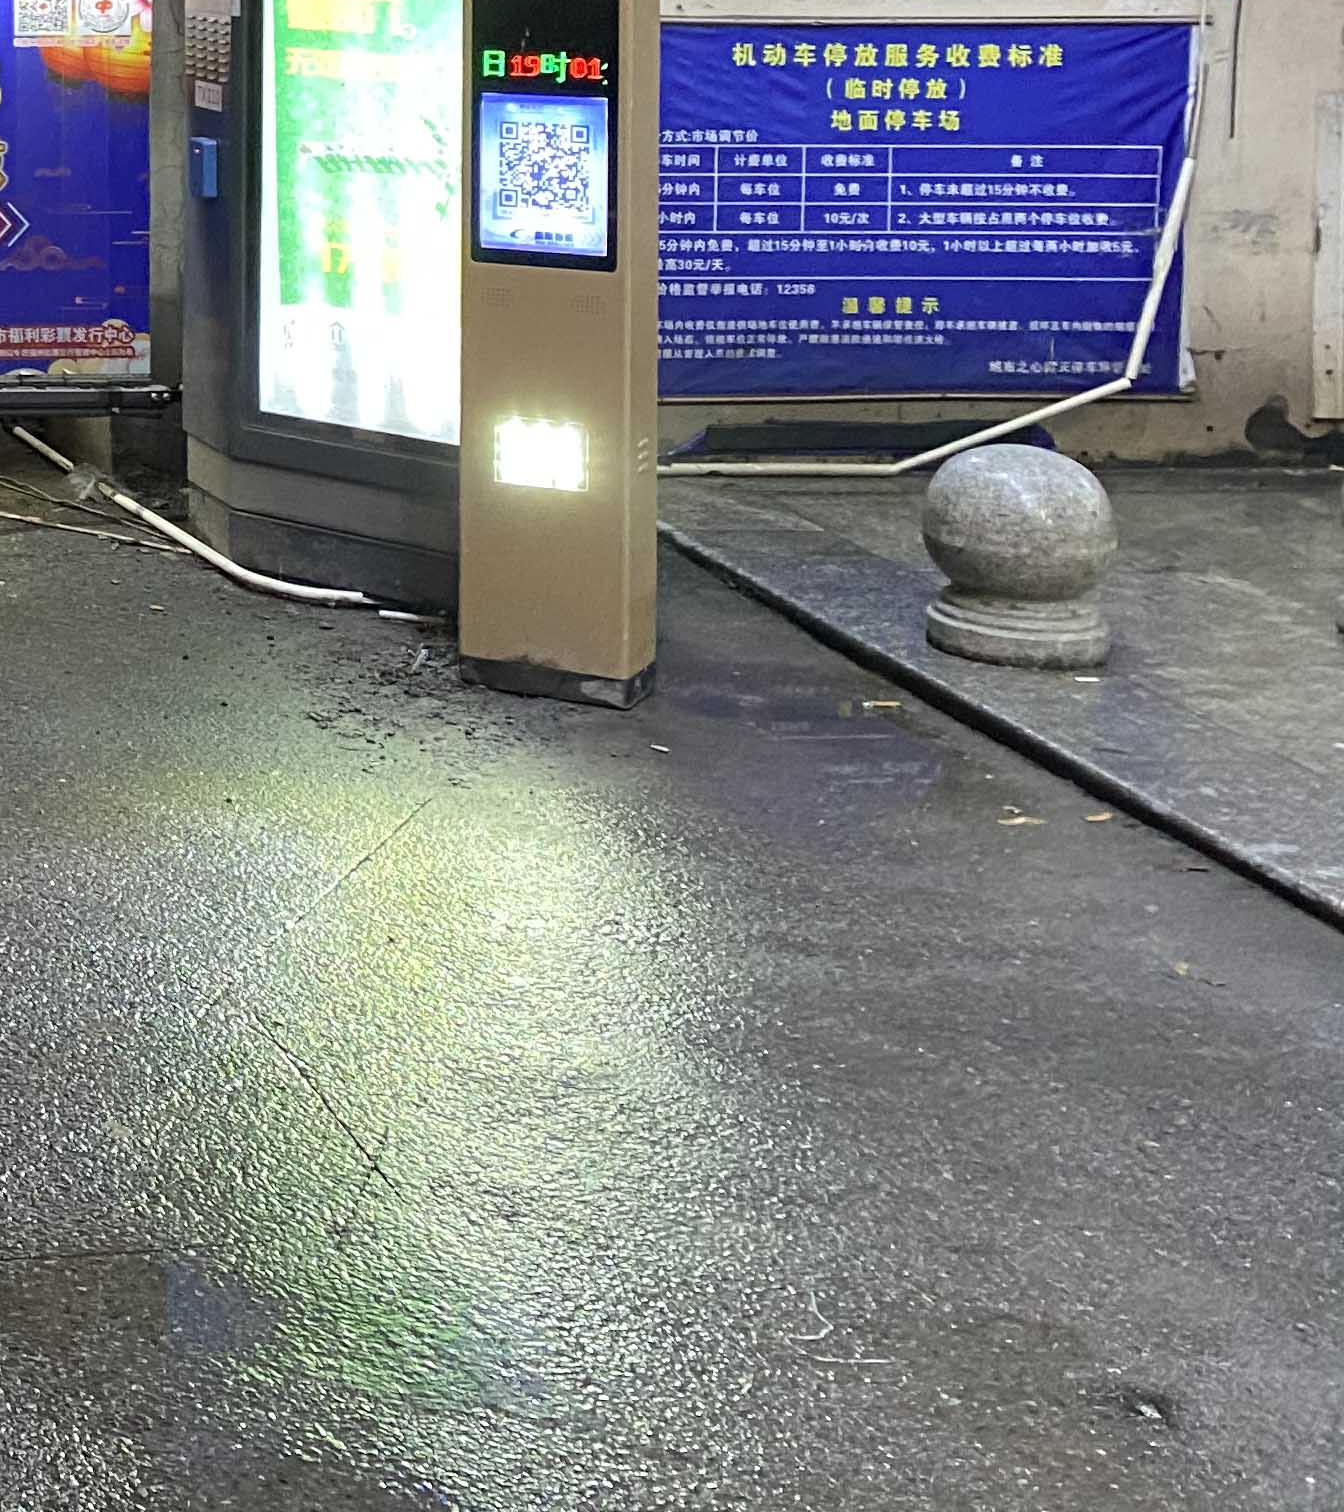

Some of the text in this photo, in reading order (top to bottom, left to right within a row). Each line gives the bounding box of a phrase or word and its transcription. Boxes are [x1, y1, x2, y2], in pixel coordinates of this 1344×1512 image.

[732, 43, 1064, 68] 机动车停放服务收费标准
[831, 110, 961, 131] 地面停车场
[834, 183, 861, 196] 免费
